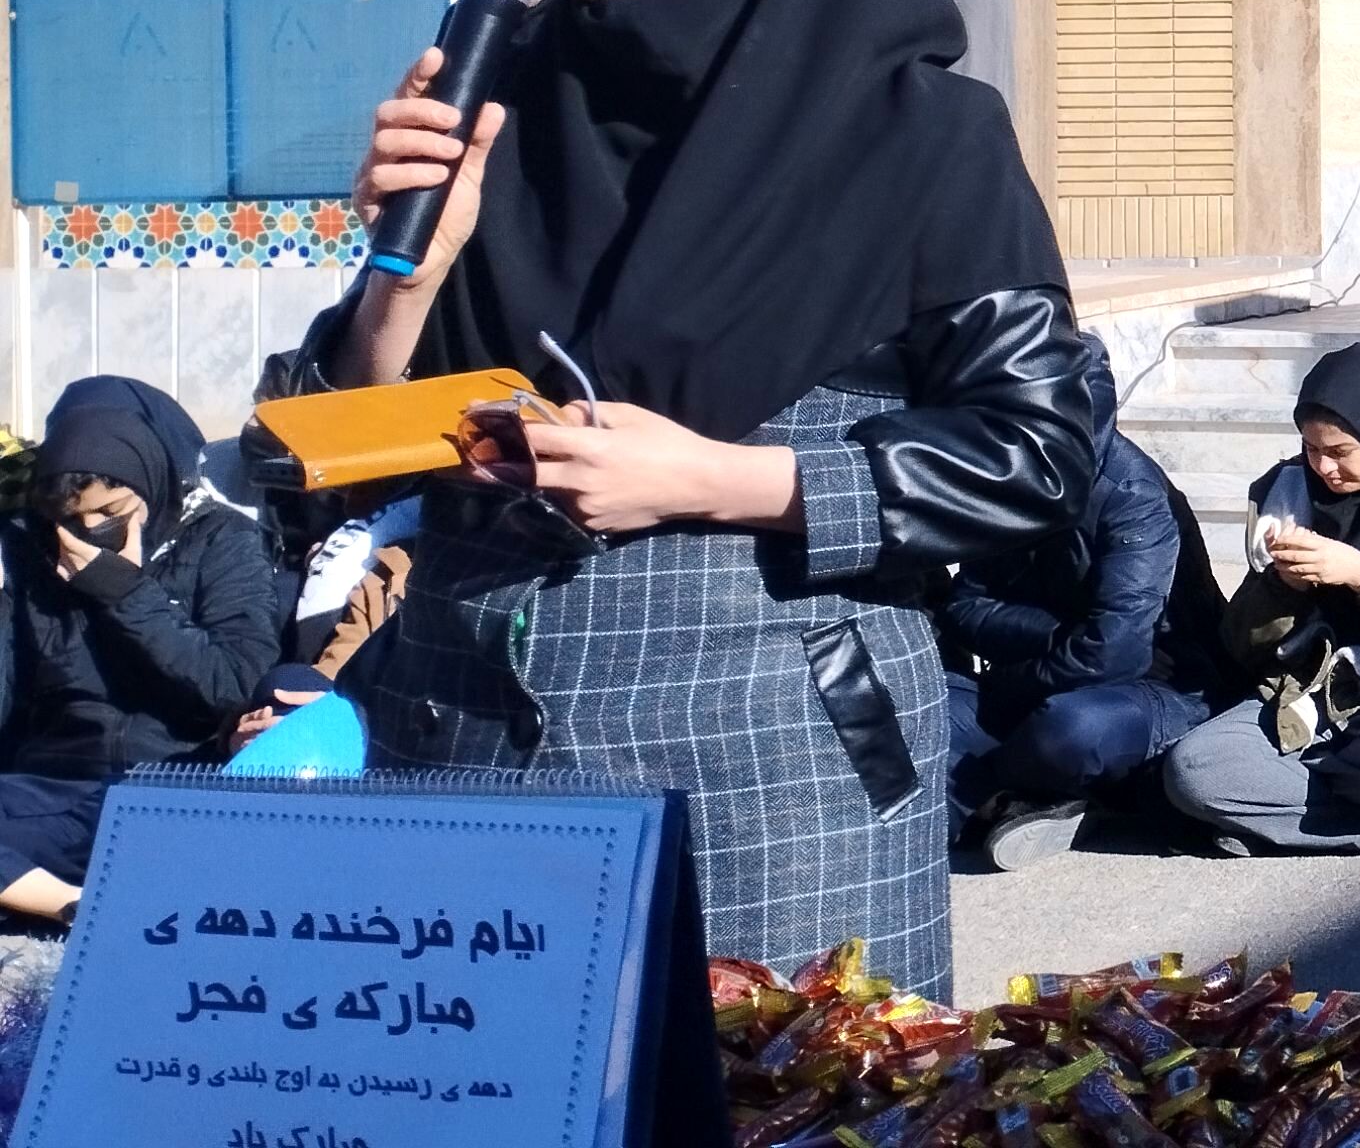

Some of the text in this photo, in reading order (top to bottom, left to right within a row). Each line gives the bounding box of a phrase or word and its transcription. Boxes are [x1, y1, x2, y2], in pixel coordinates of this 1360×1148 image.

[143, 905, 545, 964] ایام فرخنده دهه ی
[176, 975, 476, 1036] مبارکه ی فجر
[115, 1055, 182, 1083] قدرت
[187, 1063, 201, 1086] و
[207, 1061, 268, 1088] بلندی
[274, 1065, 311, 1093] اوج
[317, 1072, 341, 1093] به
[347, 1074, 433, 1101] رسیدن
[467, 1081, 513, 1098] دهه
